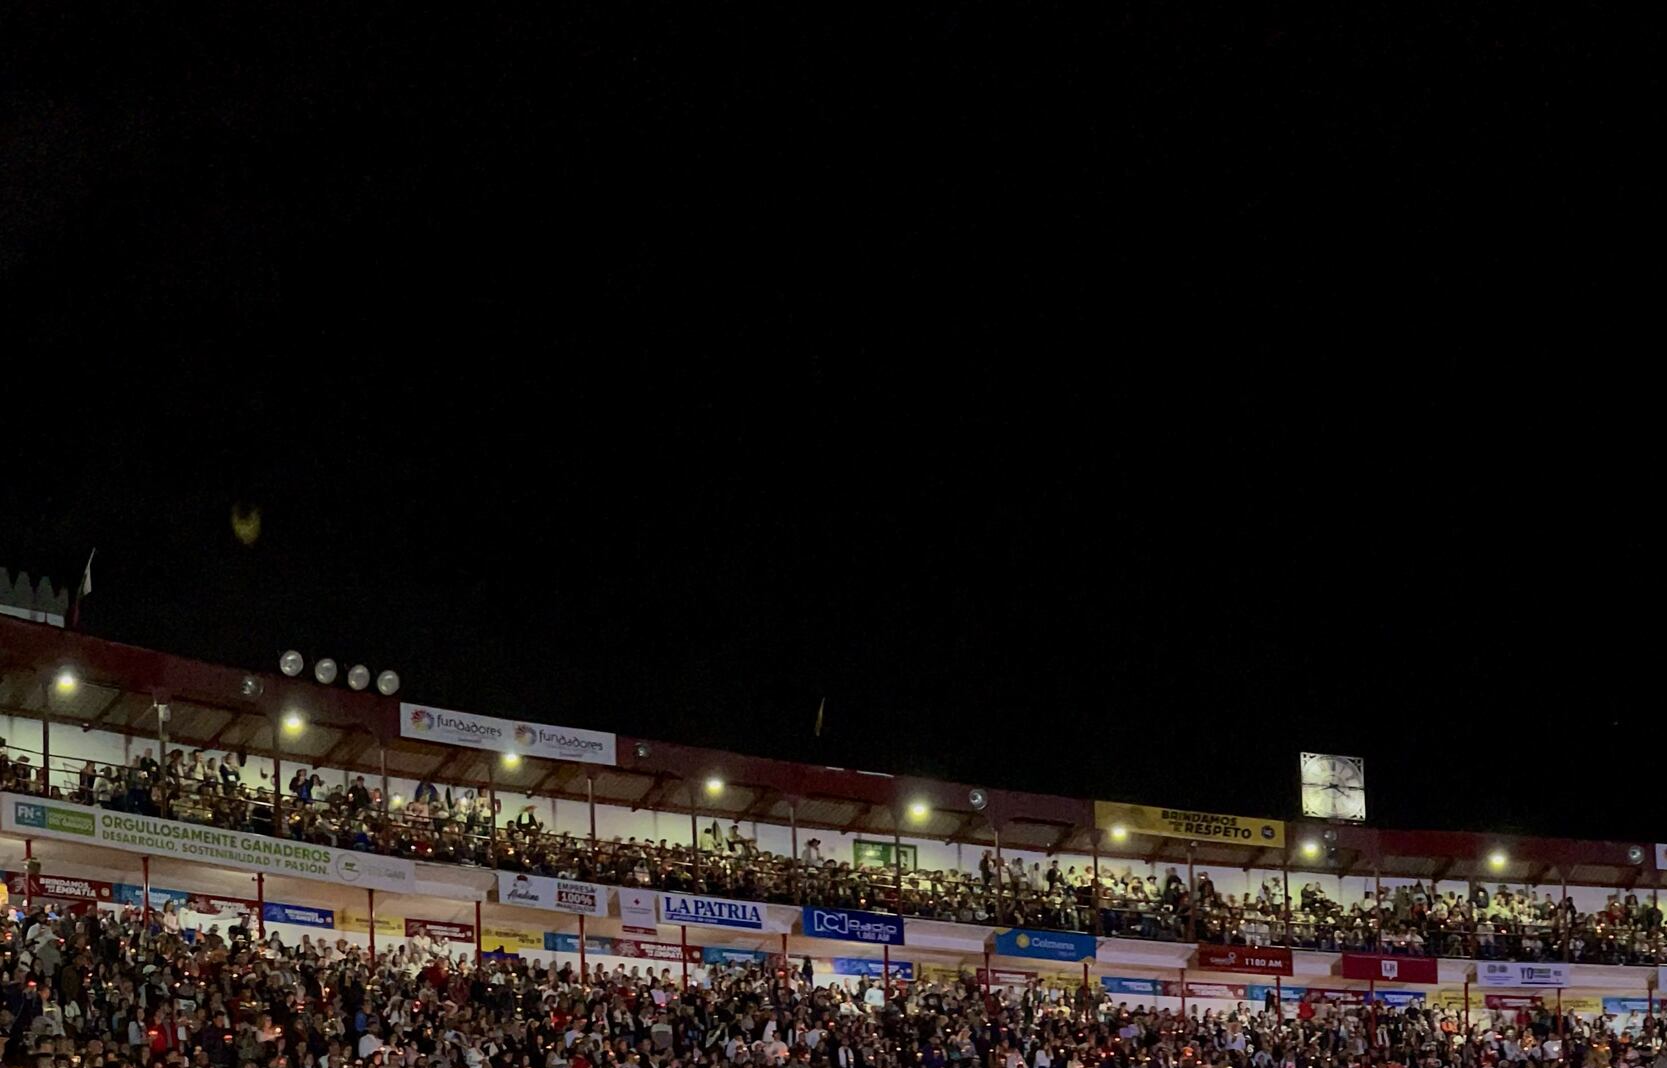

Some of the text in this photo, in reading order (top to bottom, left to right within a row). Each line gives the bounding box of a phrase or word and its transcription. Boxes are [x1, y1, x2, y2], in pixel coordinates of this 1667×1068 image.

[437, 714, 503, 738] fundadores
[539, 730, 604, 752] fundadores
[1161, 808, 1238, 827] BRINDAMOS
[102, 814, 238, 849] ORGULLOSAMENTE
[241, 837, 332, 864] GANADEROS
[1185, 822, 1252, 840] RESPETO
[102, 831, 178, 854] DESARROLLO,
[182, 843, 271, 867] SOSTENIBILIDAD
[285, 859, 330, 876] PASIÓN.
[40, 877, 90, 889] BRINDAMOS
[561, 893, 593, 907] 100%
[665, 896, 761, 922] LA PATRIA
[814, 910, 849, 934] RCN
